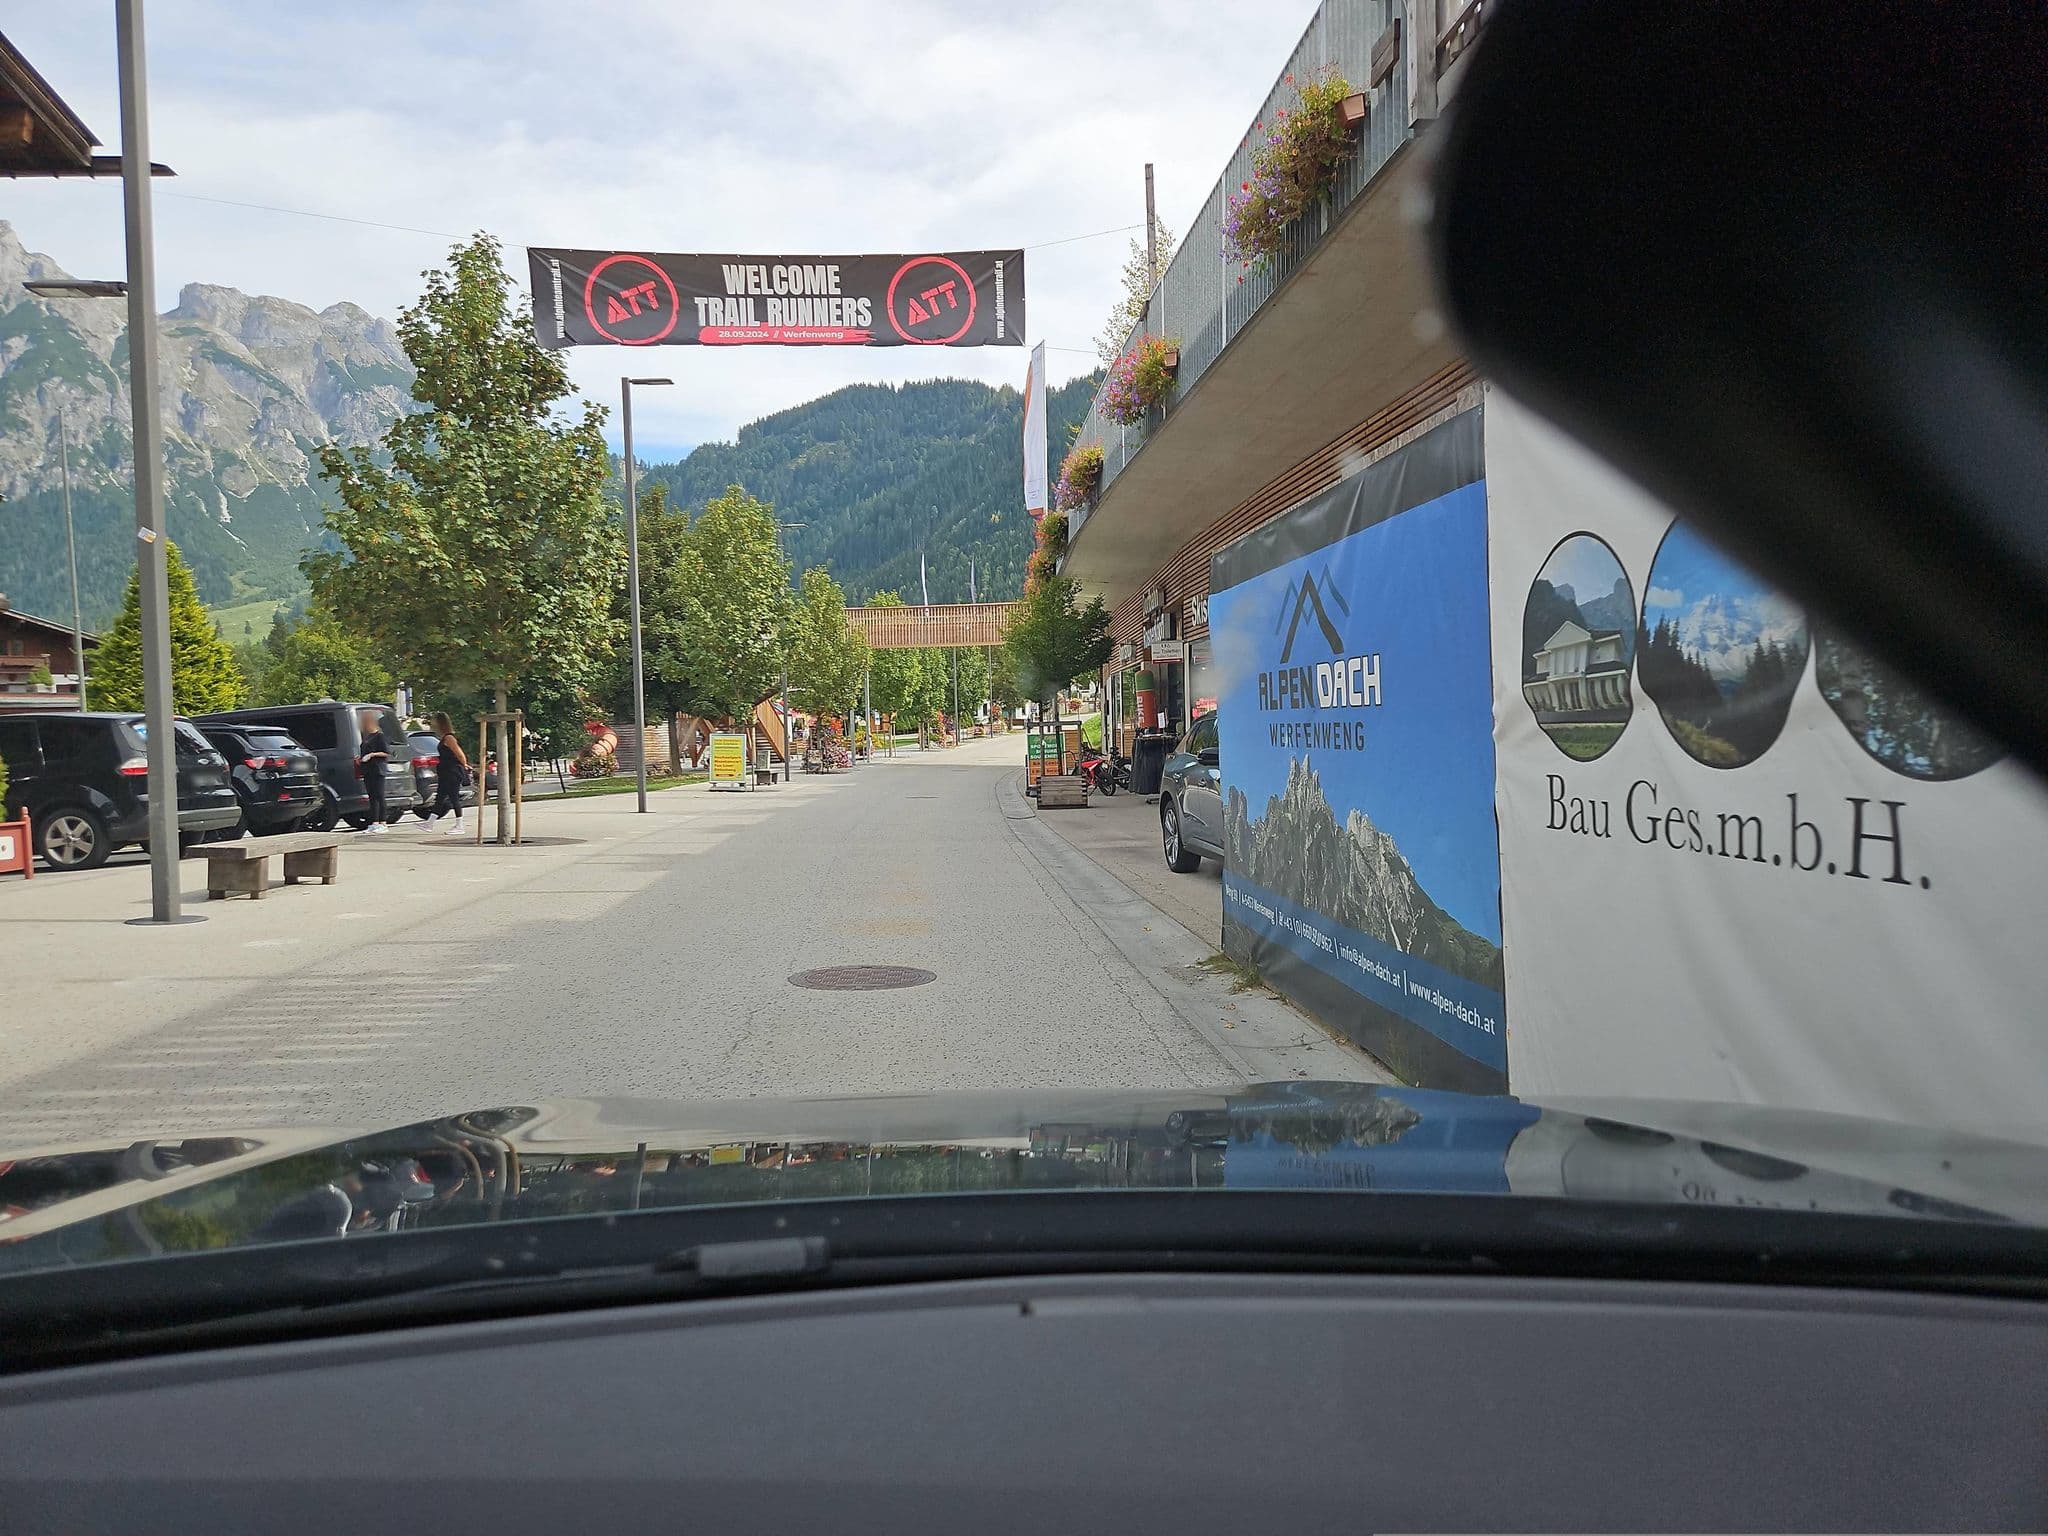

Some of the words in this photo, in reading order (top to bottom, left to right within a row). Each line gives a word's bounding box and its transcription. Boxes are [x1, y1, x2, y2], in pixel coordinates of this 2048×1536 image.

[722, 264, 840, 295] WELCOME
[607, 280, 658, 324] ATT
[694, 297, 760, 327] TRAIL
[767, 297, 872, 327] RUNNERS
[908, 280, 958, 326] ATT
[718, 330, 769, 338] 28.09.2024
[783, 330, 844, 339] Werfenweng
[1269, 721, 1365, 751] WERFENWENG
[1546, 774, 1612, 839] Bau
[1625, 780, 1931, 890] Ges.m.b.H.
[1340, 943, 1401, 988] info@alpen-dach.at
[1409, 980, 1496, 1035] www.alpen-dach.at
